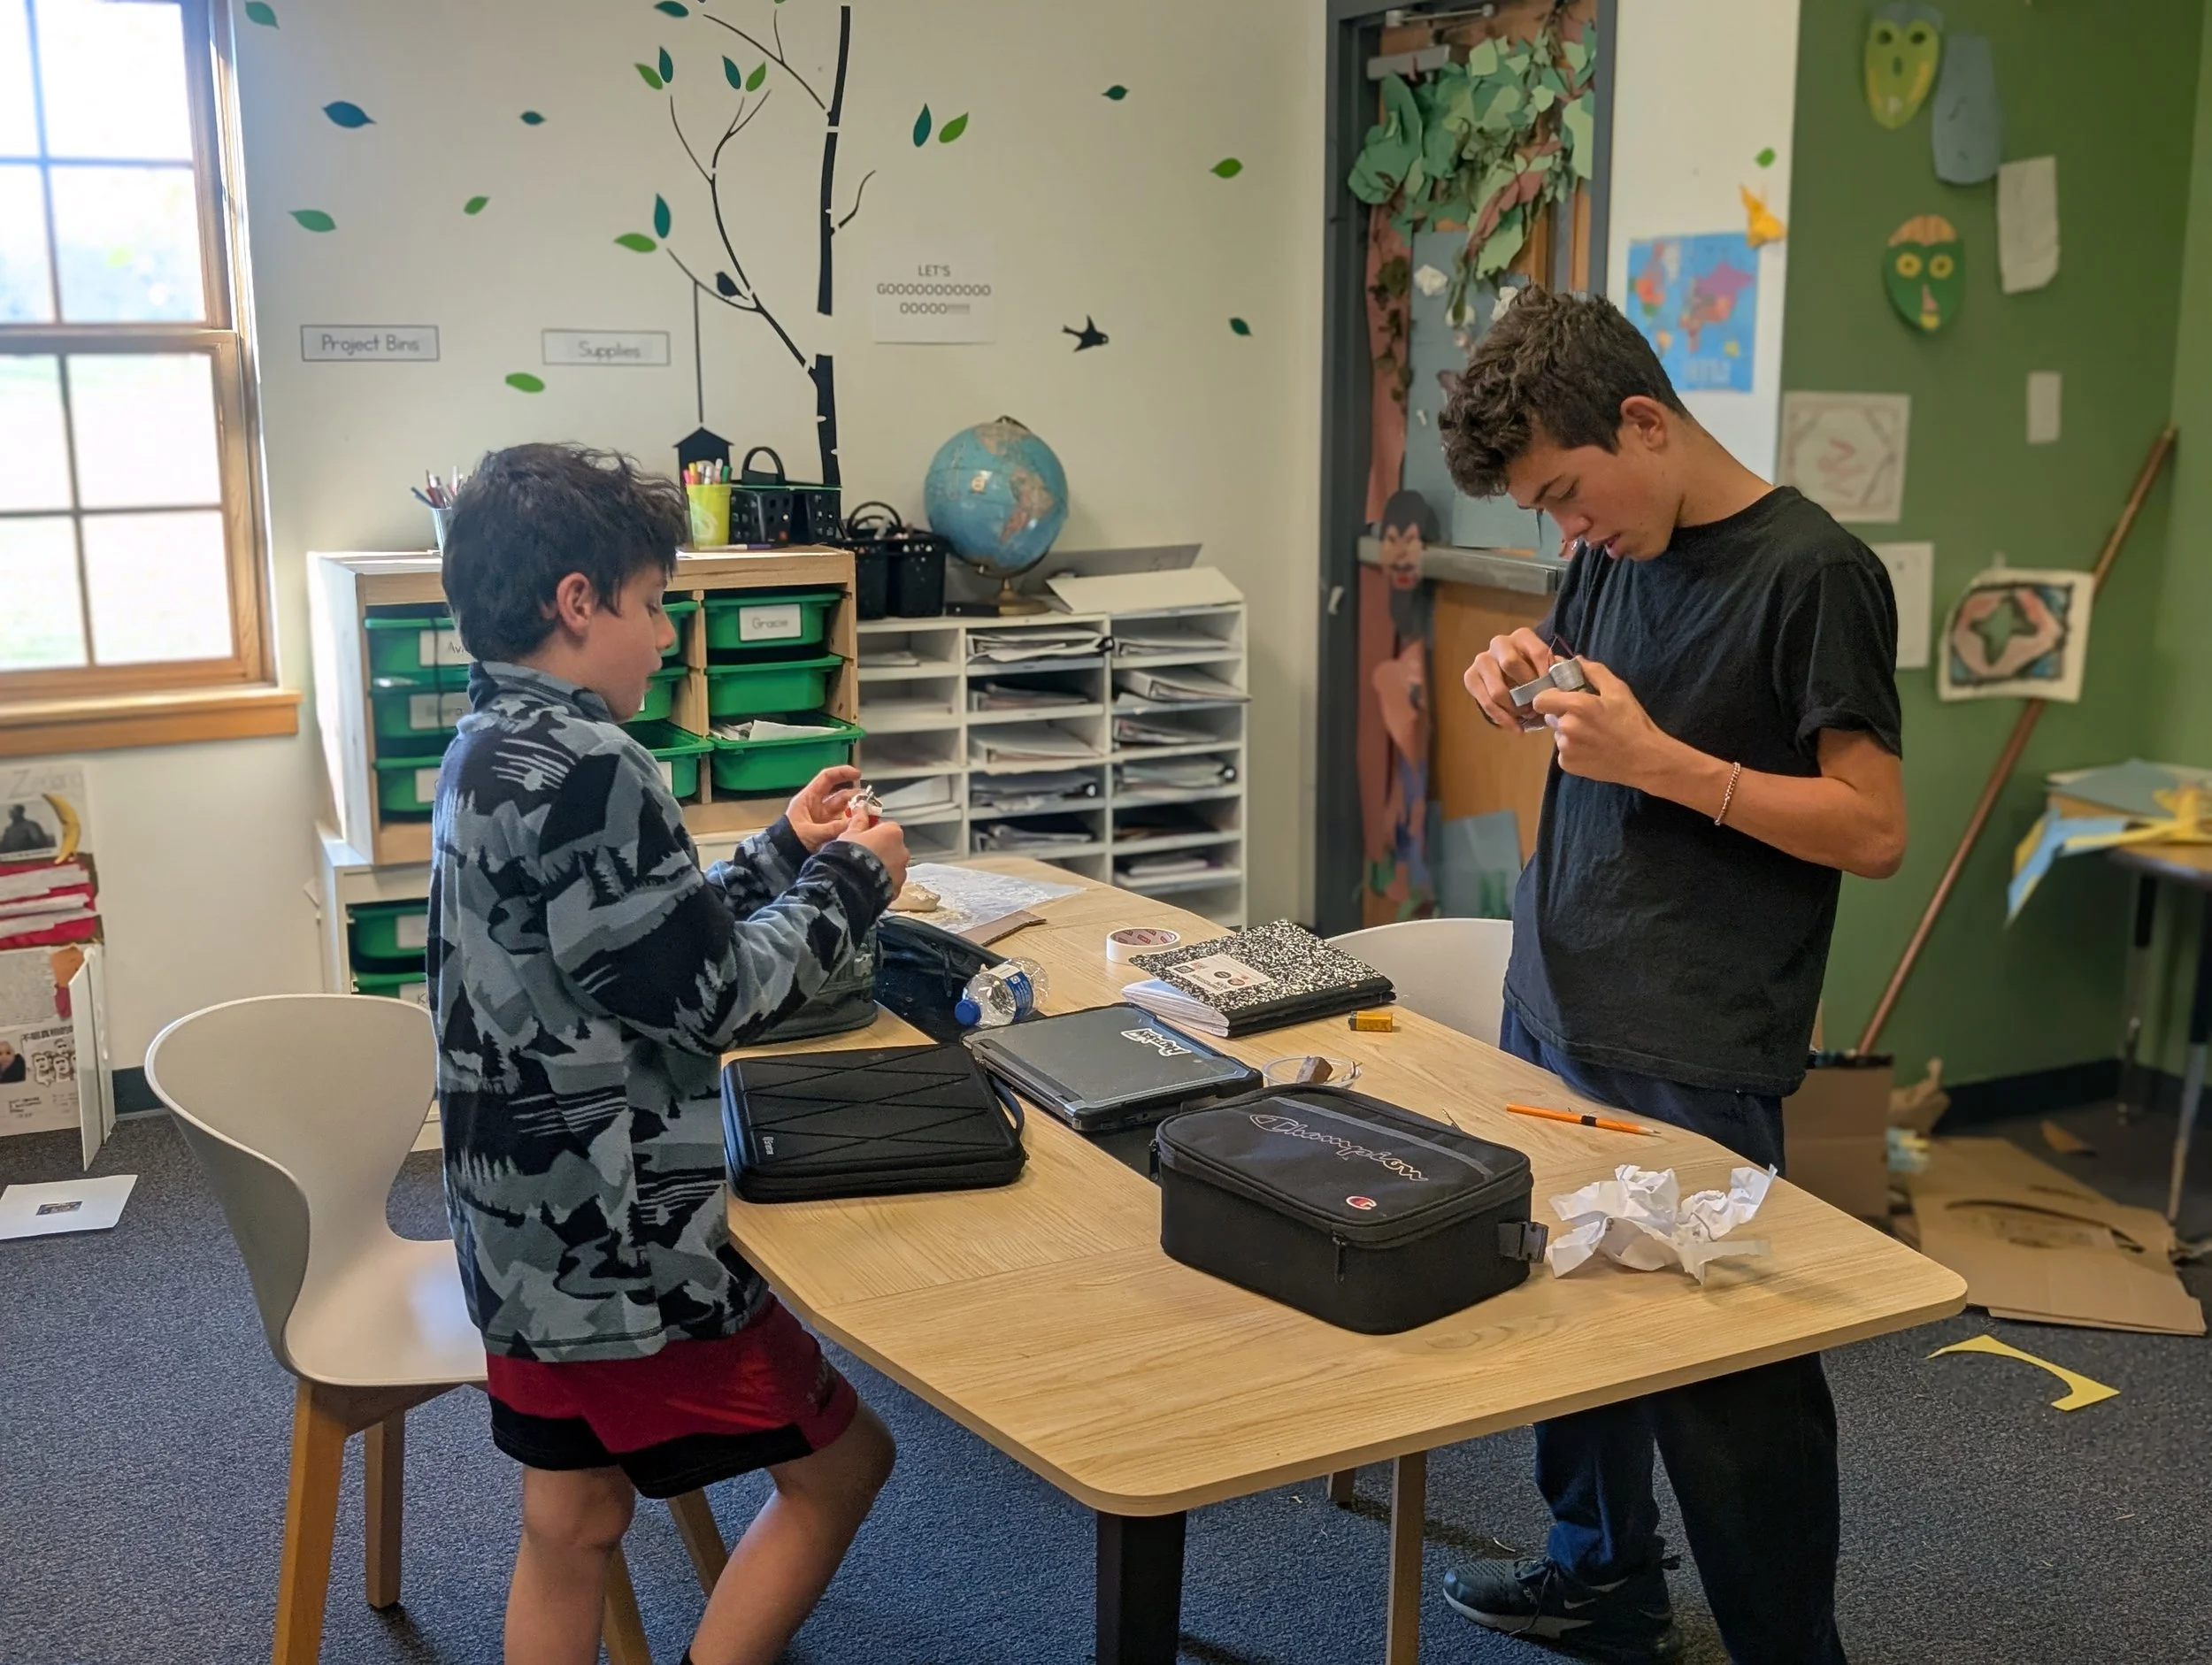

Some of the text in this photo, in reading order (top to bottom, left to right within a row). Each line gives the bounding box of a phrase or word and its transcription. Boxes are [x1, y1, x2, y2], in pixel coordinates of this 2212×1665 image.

[918, 265, 951, 277] LET'S
[321, 333, 420, 356] Project Bins
[577, 340, 641, 361] Supplies
[1248, 1114, 1429, 1182] Champion
